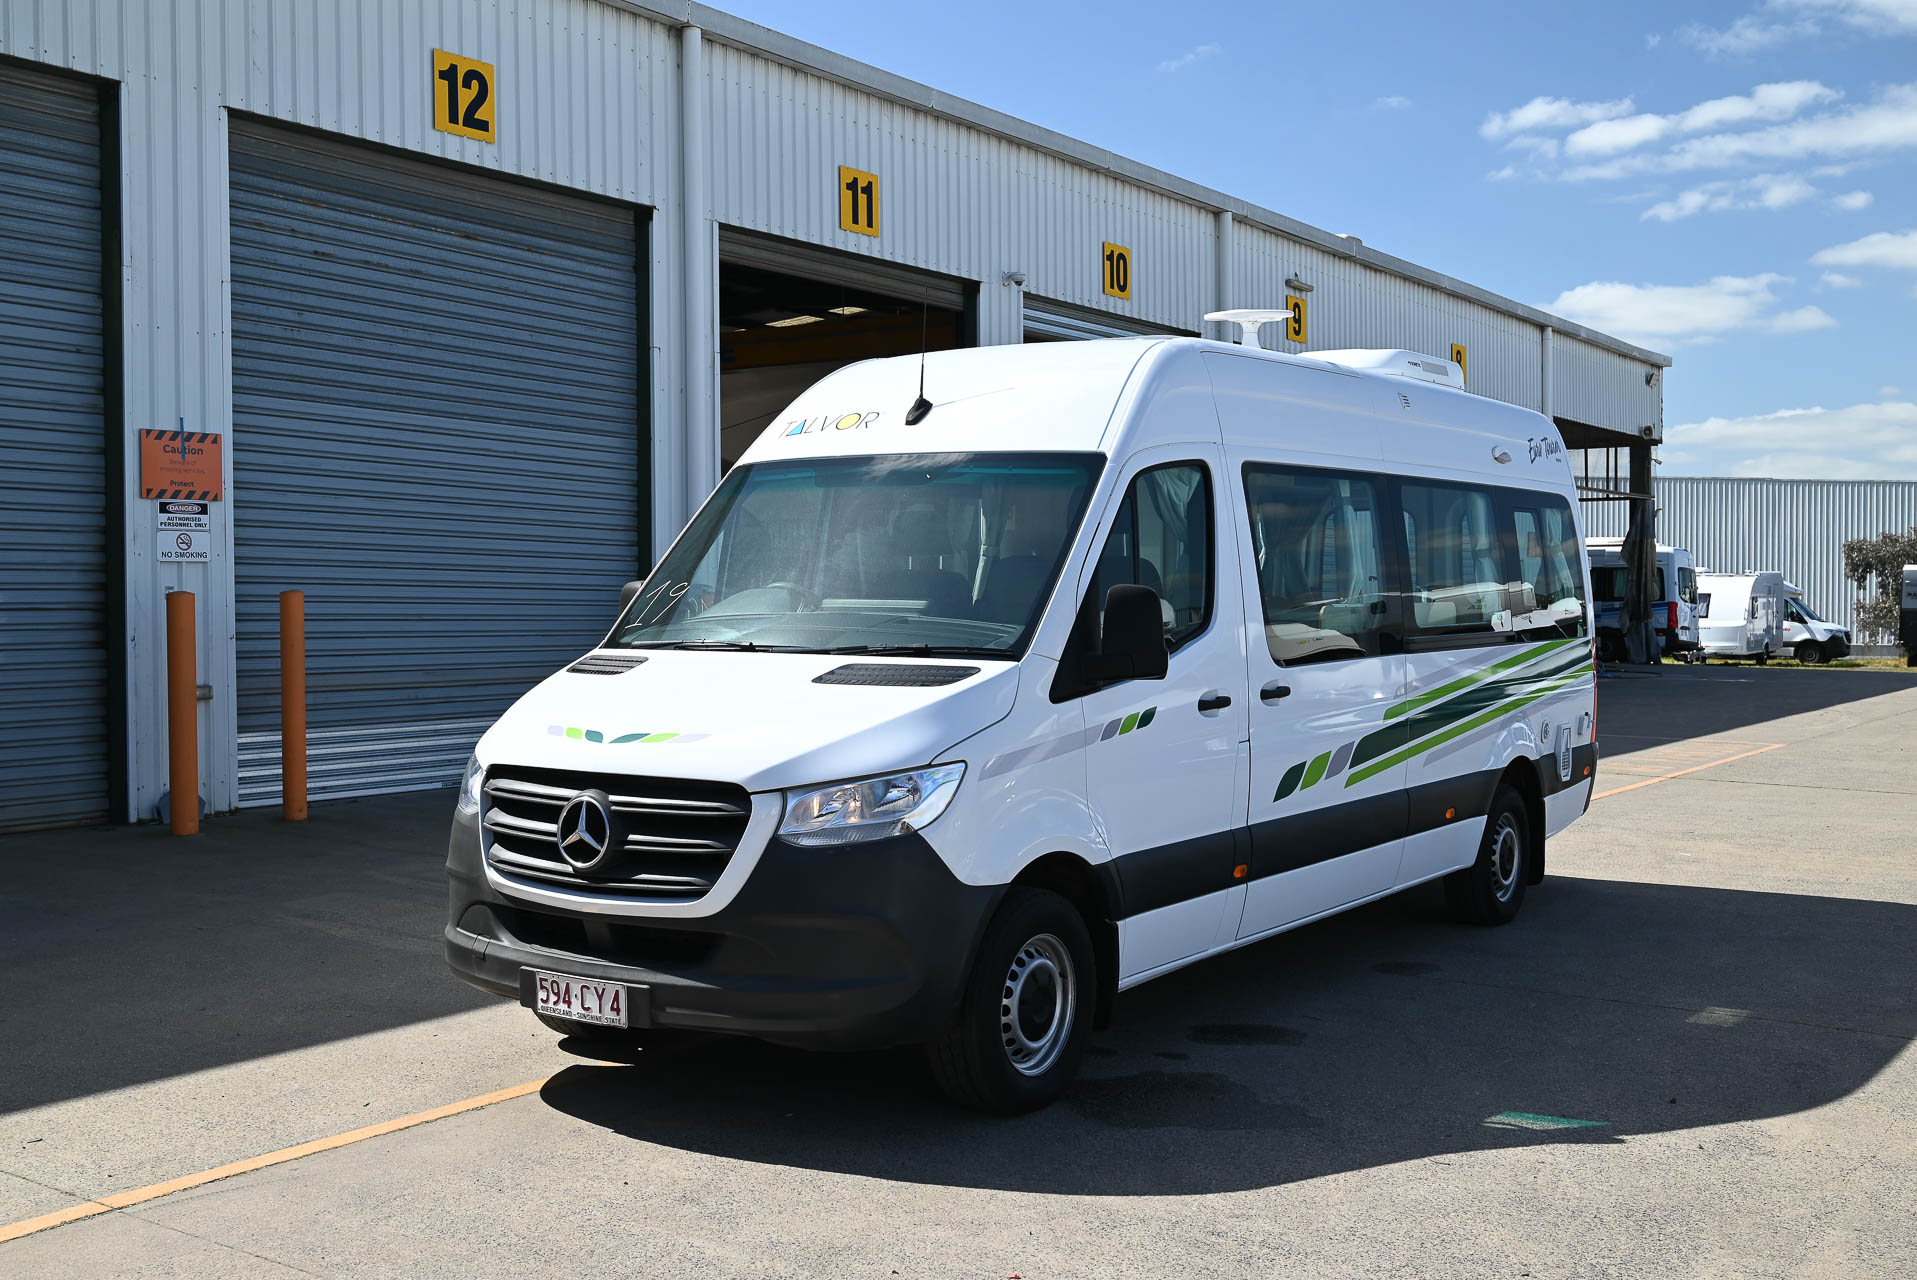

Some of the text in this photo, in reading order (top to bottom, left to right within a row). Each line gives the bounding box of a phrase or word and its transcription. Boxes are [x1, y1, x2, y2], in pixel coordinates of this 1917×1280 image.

[438, 63, 490, 133] 12
[845, 176, 874, 229] 11
[1105, 249, 1128, 293] 10
[1292, 301, 1302, 337] 9
[778, 411, 880, 439] TALVOR
[161, 551, 208, 559] NO SMOKING
[540, 1005, 573, 1017] QUEENSLAND
[604, 1017, 622, 1025] STATE
